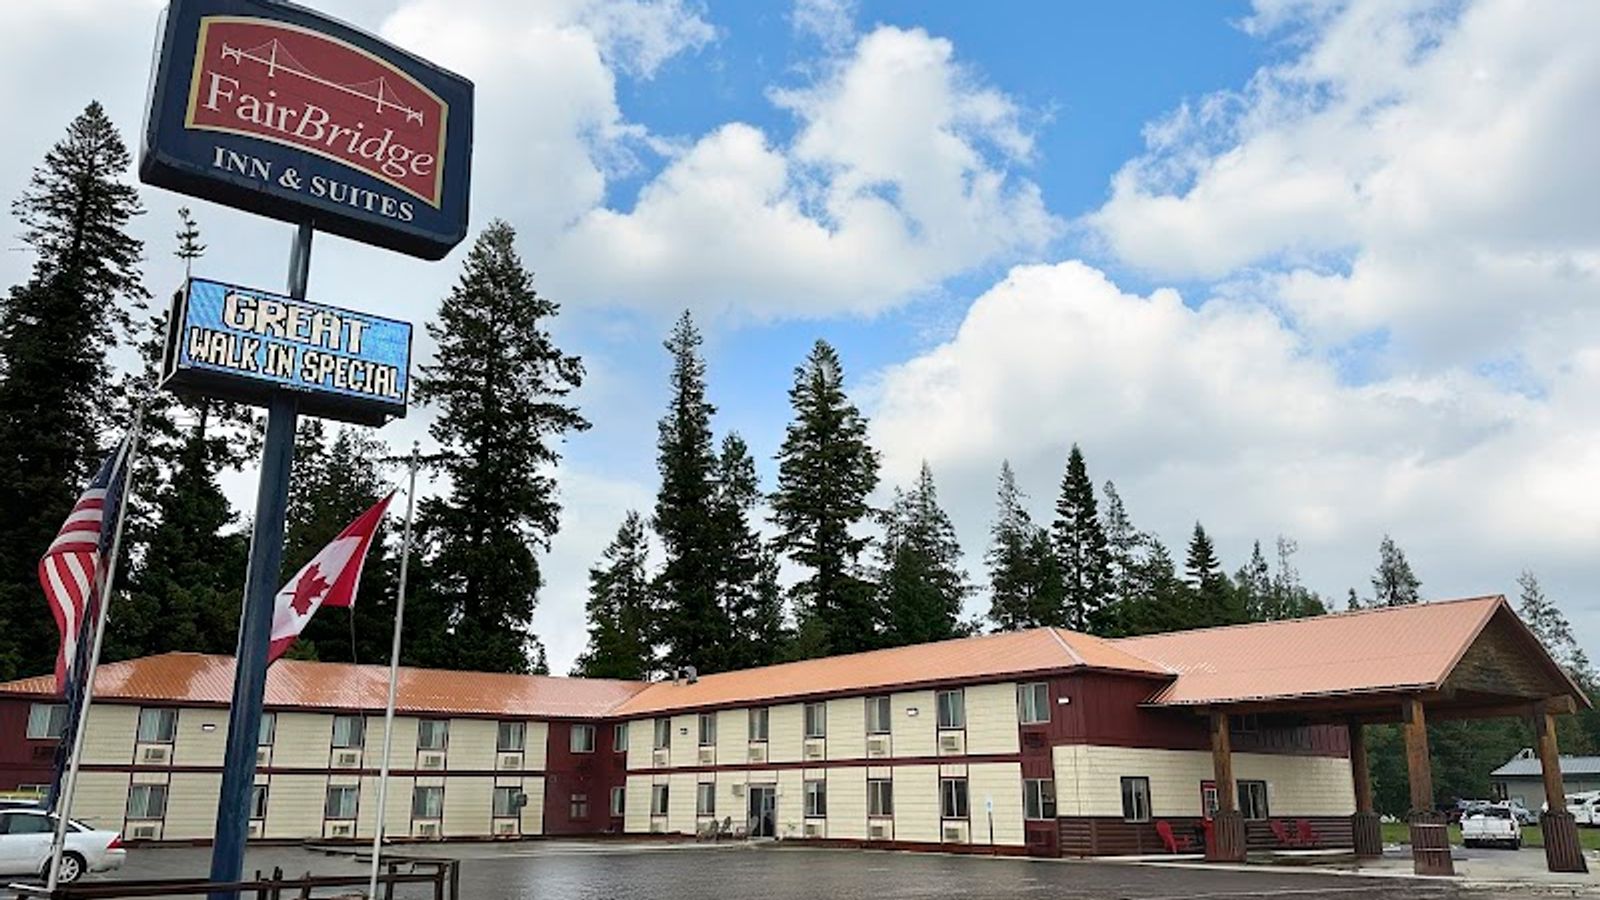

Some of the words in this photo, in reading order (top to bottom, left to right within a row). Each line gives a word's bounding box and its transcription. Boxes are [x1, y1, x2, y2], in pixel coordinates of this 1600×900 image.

[202, 70, 434, 178] FairBridge
[212, 145, 271, 181] INN
[278, 166, 302, 190] &
[309, 175, 415, 222] SUITES
[224, 292, 369, 355] GREAT
[189, 326, 259, 372] WALK
[264, 342, 297, 380] IN
[301, 350, 404, 399] SPECIAL
